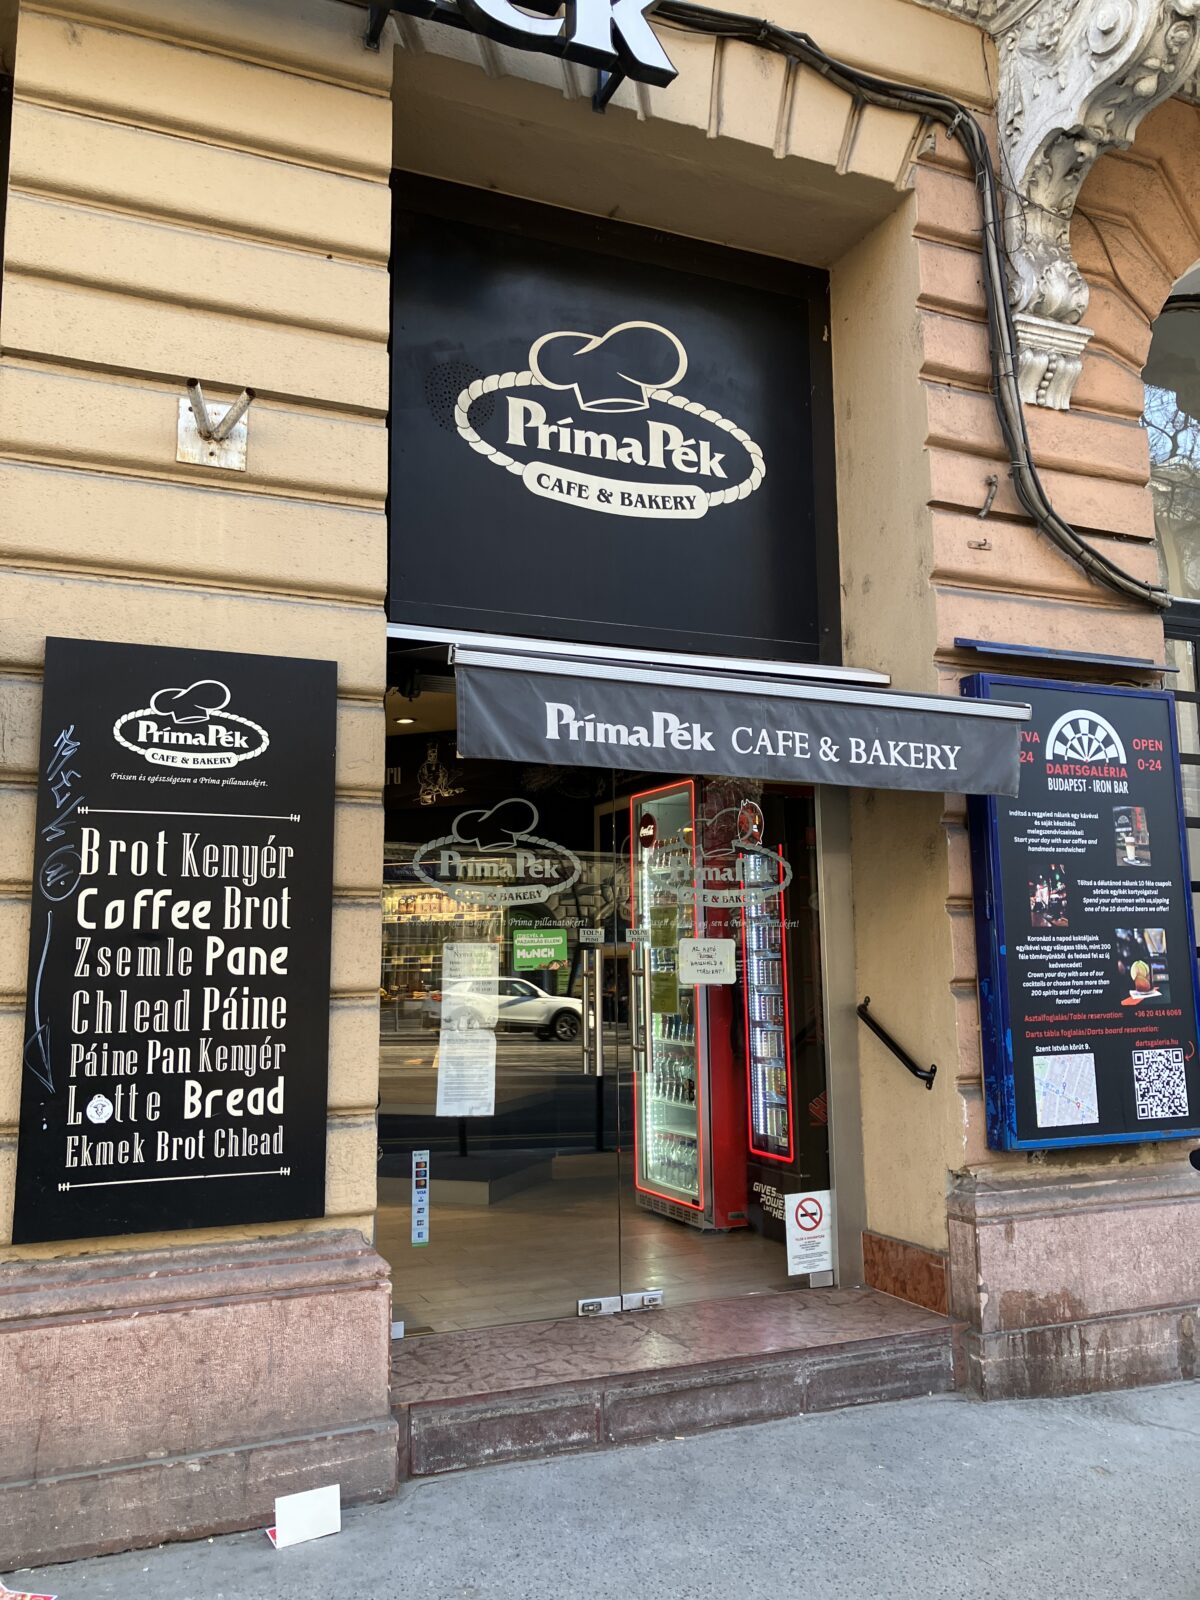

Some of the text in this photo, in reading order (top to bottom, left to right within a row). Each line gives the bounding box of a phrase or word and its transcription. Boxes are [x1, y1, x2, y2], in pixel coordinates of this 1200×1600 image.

[506, 396, 728, 478] PrímaPék
[536, 472, 697, 511] CAFE & BAKERY
[137, 720, 249, 748] PrímaPék
[545, 701, 960, 771] PrímaPék CAFE & BAKERY
[1132, 739, 1163, 751] OPEN
[152, 752, 177, 763] CAFE
[192, 757, 232, 765] BAKERY
[1046, 763, 1128, 778] DARTSGALÉRIA
[1138, 760, 1162, 771] 0-24
[110, 773, 137, 781] Frissen
[148, 775, 191, 784] egészségesen
[1048, 778, 1128, 793] BUDAPEST IRON BAR
[79, 828, 169, 877] Brot
[181, 832, 294, 886] Kenyér
[77, 886, 291, 930] Coffee Brot
[501, 890, 542, 900] BAKERY
[74, 936, 288, 977] Zsemle Pane
[71, 987, 287, 1034] Chlead Páine
[69, 1035, 286, 1078] Páine Pan Kenyér
[184, 1076, 285, 1119] Bread
[65, 1125, 284, 1168] Ekmek Brot Chlead
[753, 1182, 776, 1197] GIVES
[760, 1194, 785, 1210] POWE
